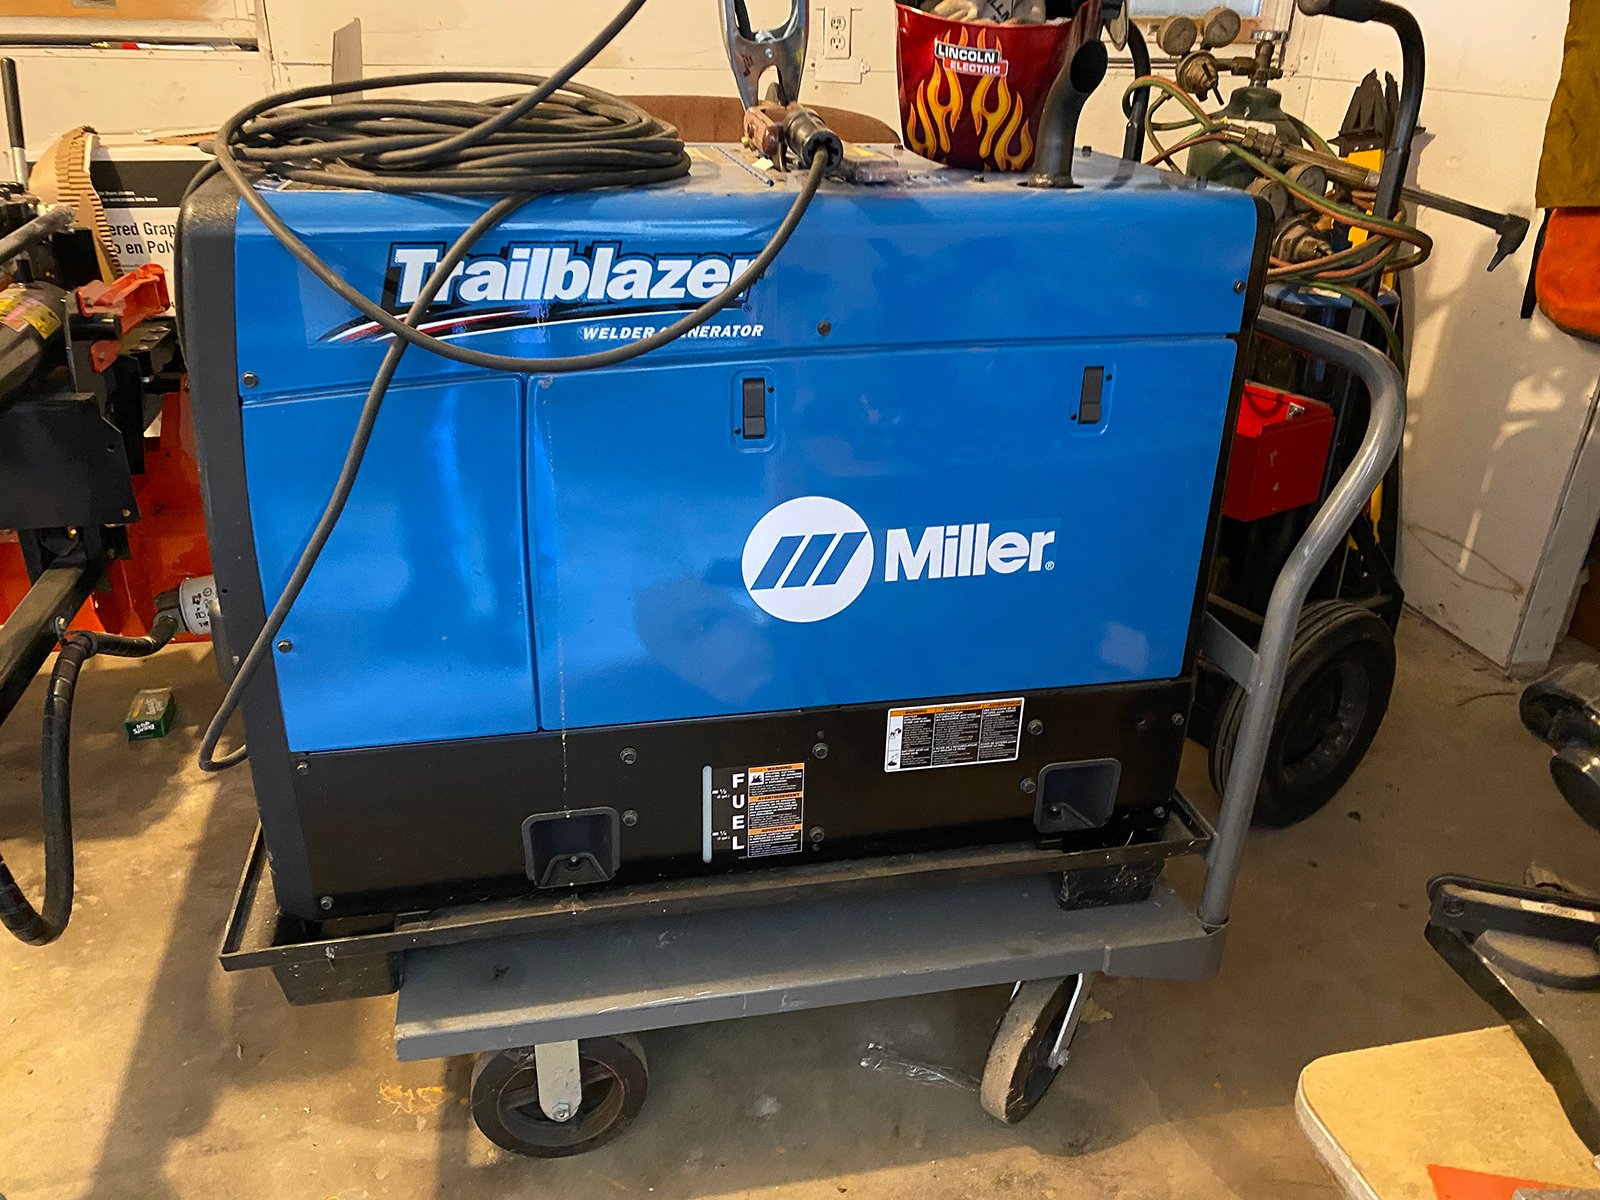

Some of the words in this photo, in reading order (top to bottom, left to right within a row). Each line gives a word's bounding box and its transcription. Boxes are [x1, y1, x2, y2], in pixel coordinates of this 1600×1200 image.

[938, 44, 995, 63] LINCOLN
[950, 60, 1001, 74] ELECTRIC
[126, 243, 143, 254] en
[583, 326, 655, 340] WELDER
[884, 523, 1055, 582] Miller
[732, 773, 745, 850] FUEL
